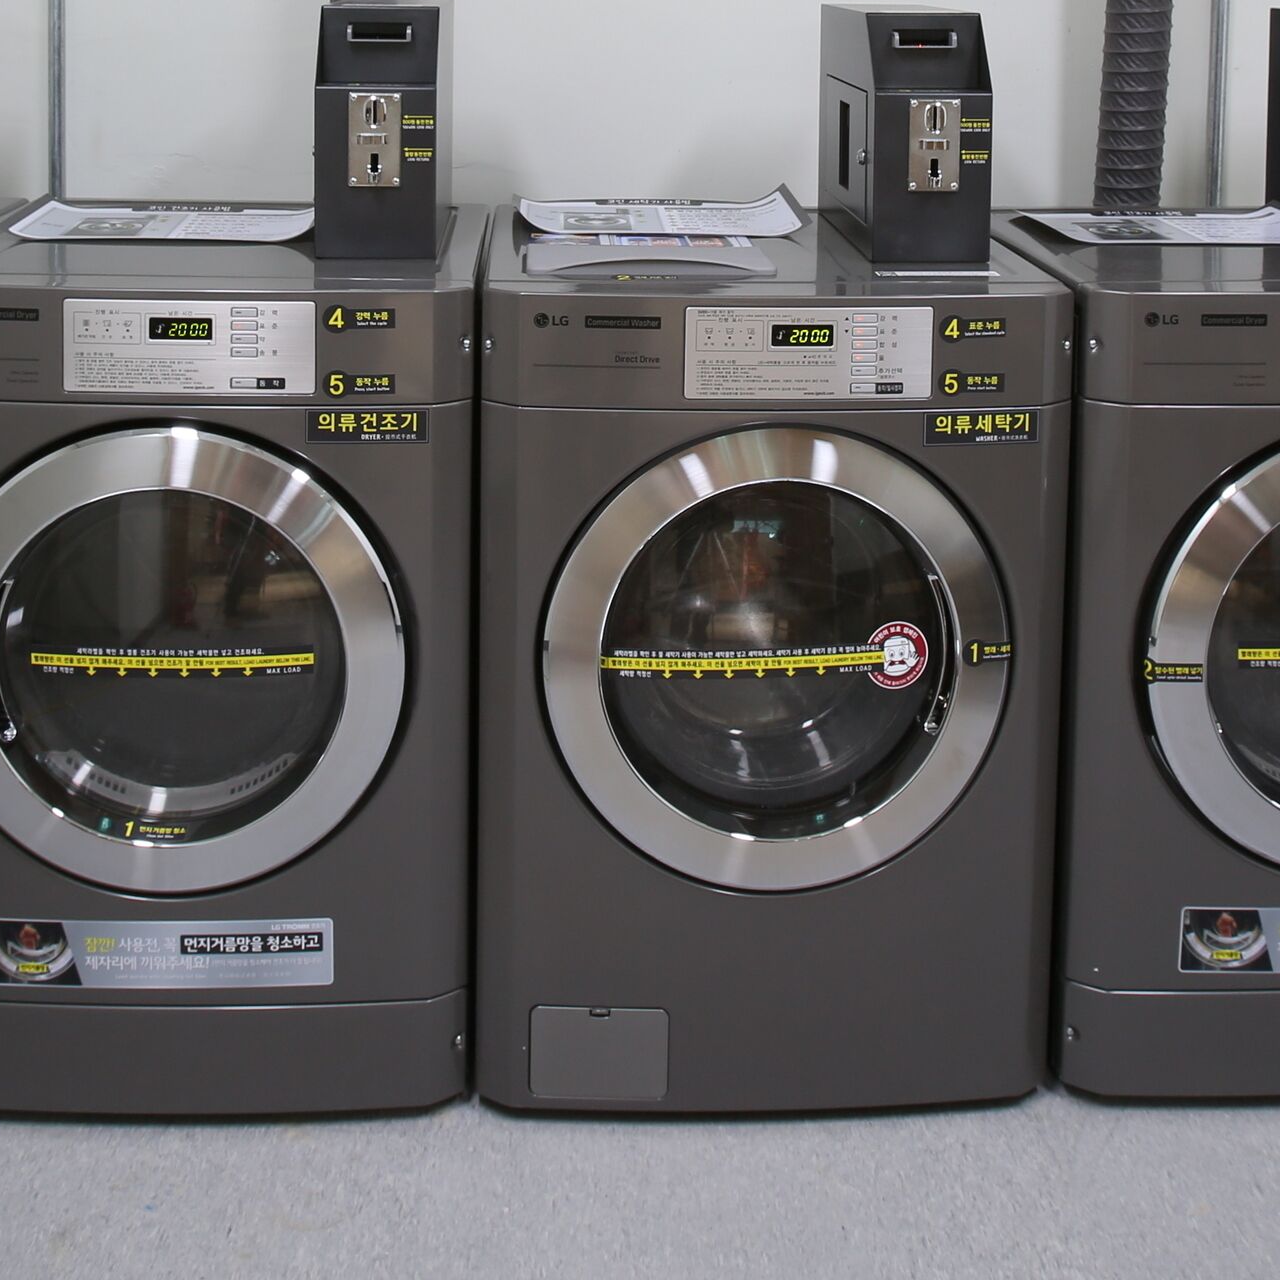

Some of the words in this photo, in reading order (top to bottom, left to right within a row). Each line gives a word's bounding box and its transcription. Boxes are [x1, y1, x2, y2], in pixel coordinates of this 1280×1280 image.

[16, 310, 38, 320] Dryer
[328, 307, 345, 328] 4
[552, 315, 569, 327] LG
[1162, 314, 1179, 325] LG
[168, 322, 209, 337] 2000
[587, 318, 630, 327] Commercial
[631, 319, 660, 328] Washer
[944, 318, 960, 339] 4
[969, 321, 984, 330] 표준
[985, 321, 1000, 330] 누름
[789, 329, 830, 344] 2000
[614, 354, 638, 364] Direct
[639, 355, 660, 364] Drive
[329, 374, 344, 395] 5
[944, 373, 959, 394] 5
[984, 376, 998, 385] 누름
[318, 412, 418, 433] 의류건조기
[935, 413, 1030, 434] 의류세탁기
[873, 628, 890, 643] 어린이
[889, 625, 901, 633] 보호
[159, 649, 176, 657] 사용이
[178, 649, 195, 657] 가능한
[640, 650, 650, 658] 확인
[748, 649, 775, 657] 세탁하세요.
[792, 648, 803, 656] 사용
[811, 647, 826, 655] 세탁기
[970, 642, 978, 663] 1
[125, 820, 135, 838] 1
[281, 923, 310, 931] TROMM
[85, 936, 116, 953] 잠깐!
[119, 936, 161, 953] 사용전,
[164, 936, 177, 953] 꼭
[184, 936, 264, 953] 먼지거름망을
[266, 934, 320, 952] 청소하고
[85, 956, 137, 971] 제자리에
[140, 955, 210, 971] 끼워주세요!
